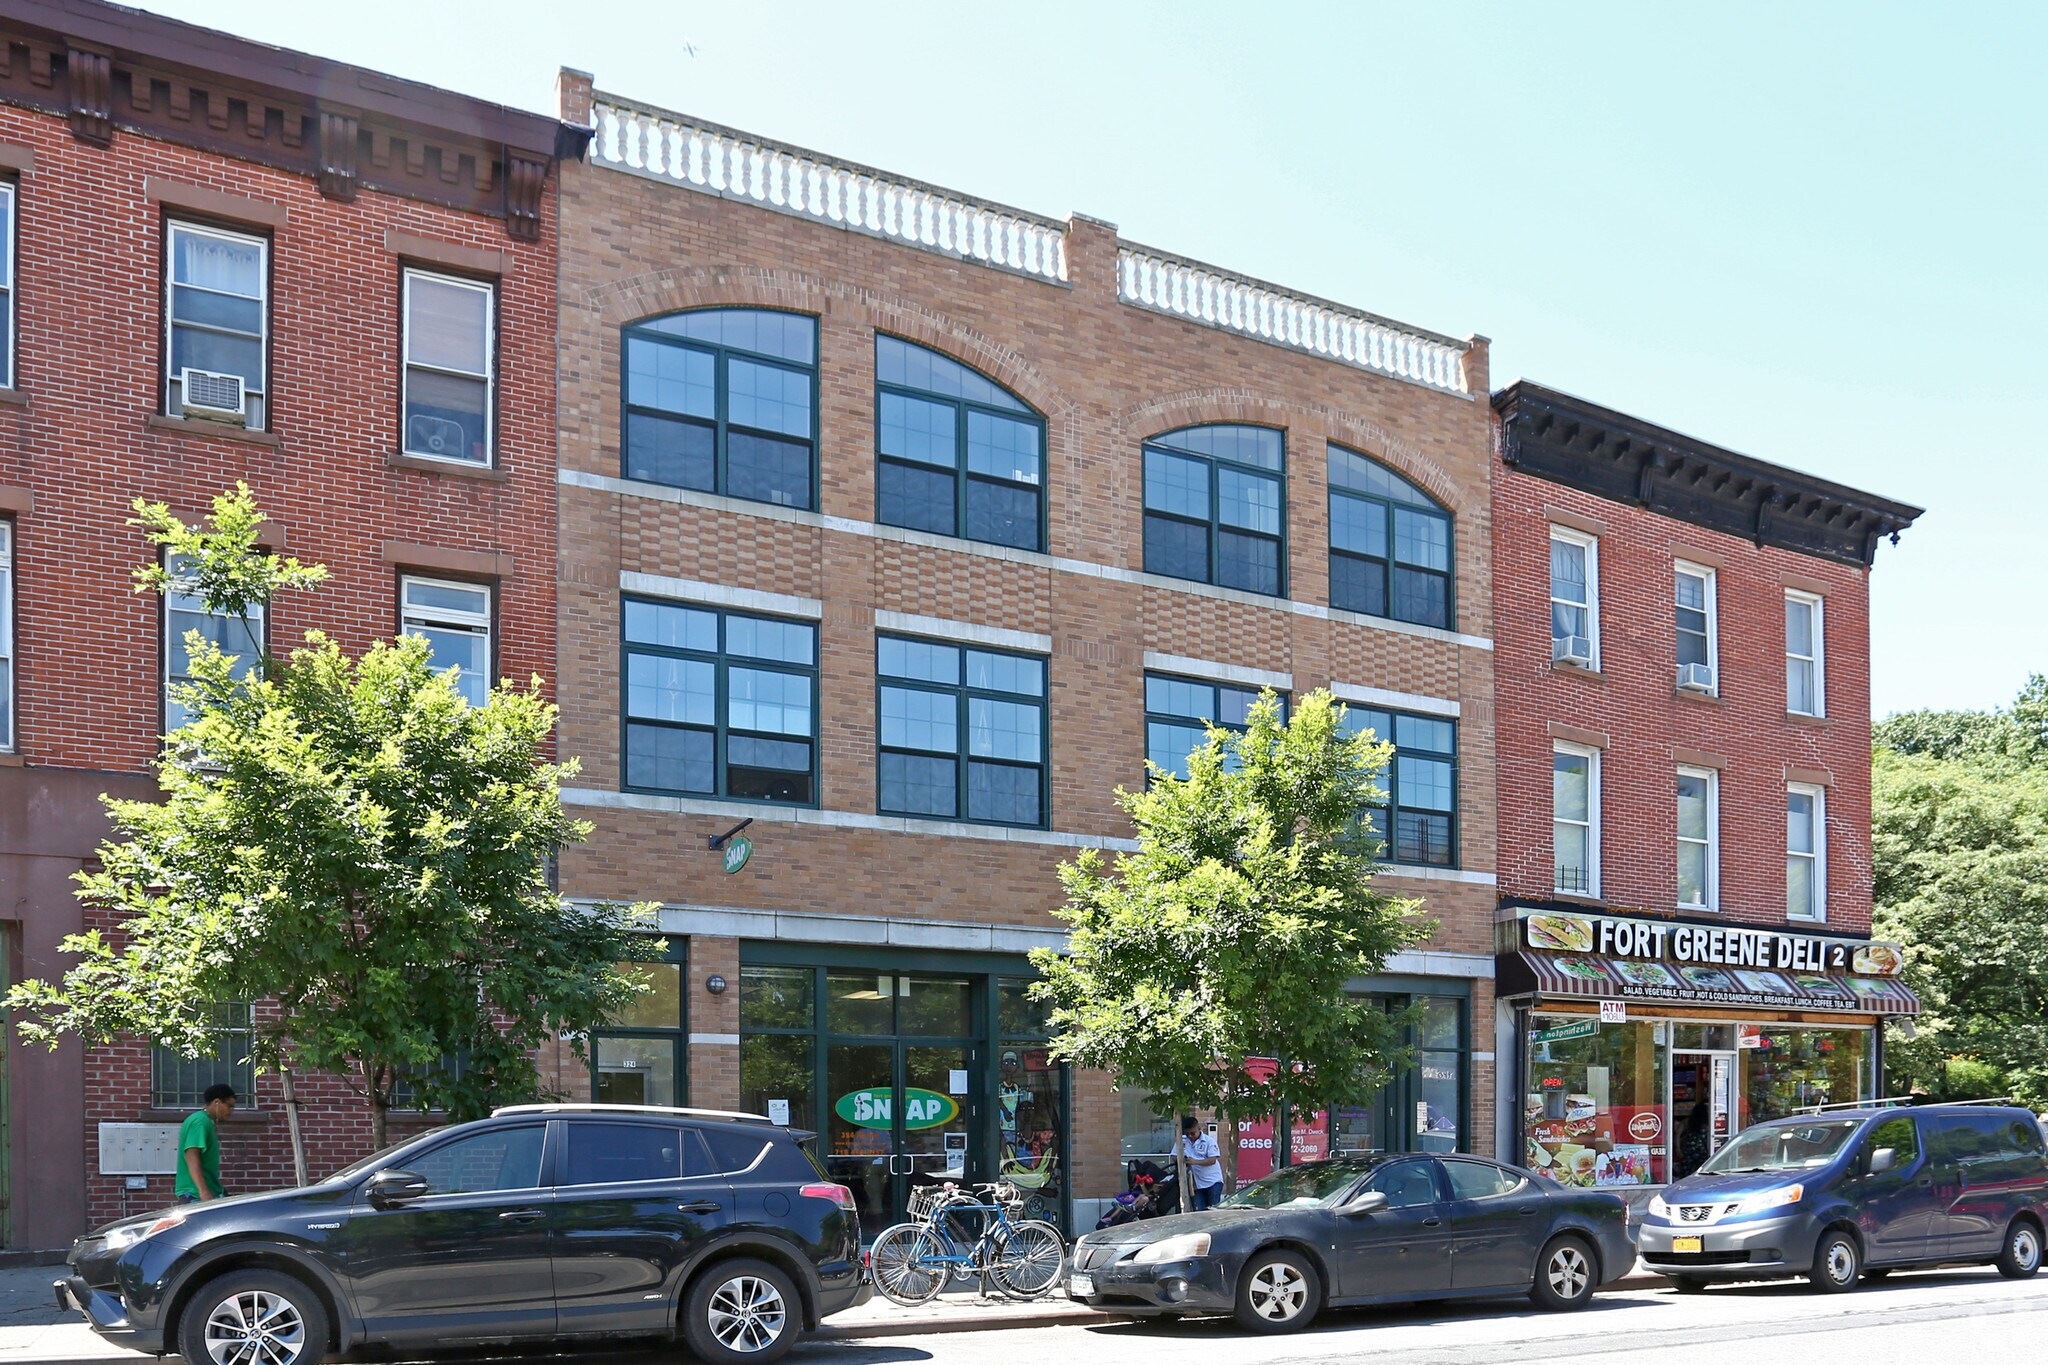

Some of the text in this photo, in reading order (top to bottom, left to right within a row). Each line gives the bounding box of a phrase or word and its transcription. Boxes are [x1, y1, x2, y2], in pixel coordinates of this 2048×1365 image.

[727, 844, 746, 870] SNAP
[1600, 919, 1845, 972] FORT GREENE DELI 2
[1679, 989, 1695, 998] FRUIT
[1708, 991, 1713, 999] &
[1713, 992, 1728, 1000] COLD
[1845, 1001, 1855, 1009] EBT
[1602, 1002, 1624, 1012] ATM
[1543, 1078, 1562, 1087] OPEN
[854, 1092, 942, 1121] SNAP
[1234, 1121, 1252, 1132] or
[1534, 1127, 1551, 1136] Fresh
[1238, 1138, 1273, 1149] ease
[1538, 1135, 1571, 1143] Sandwiches
